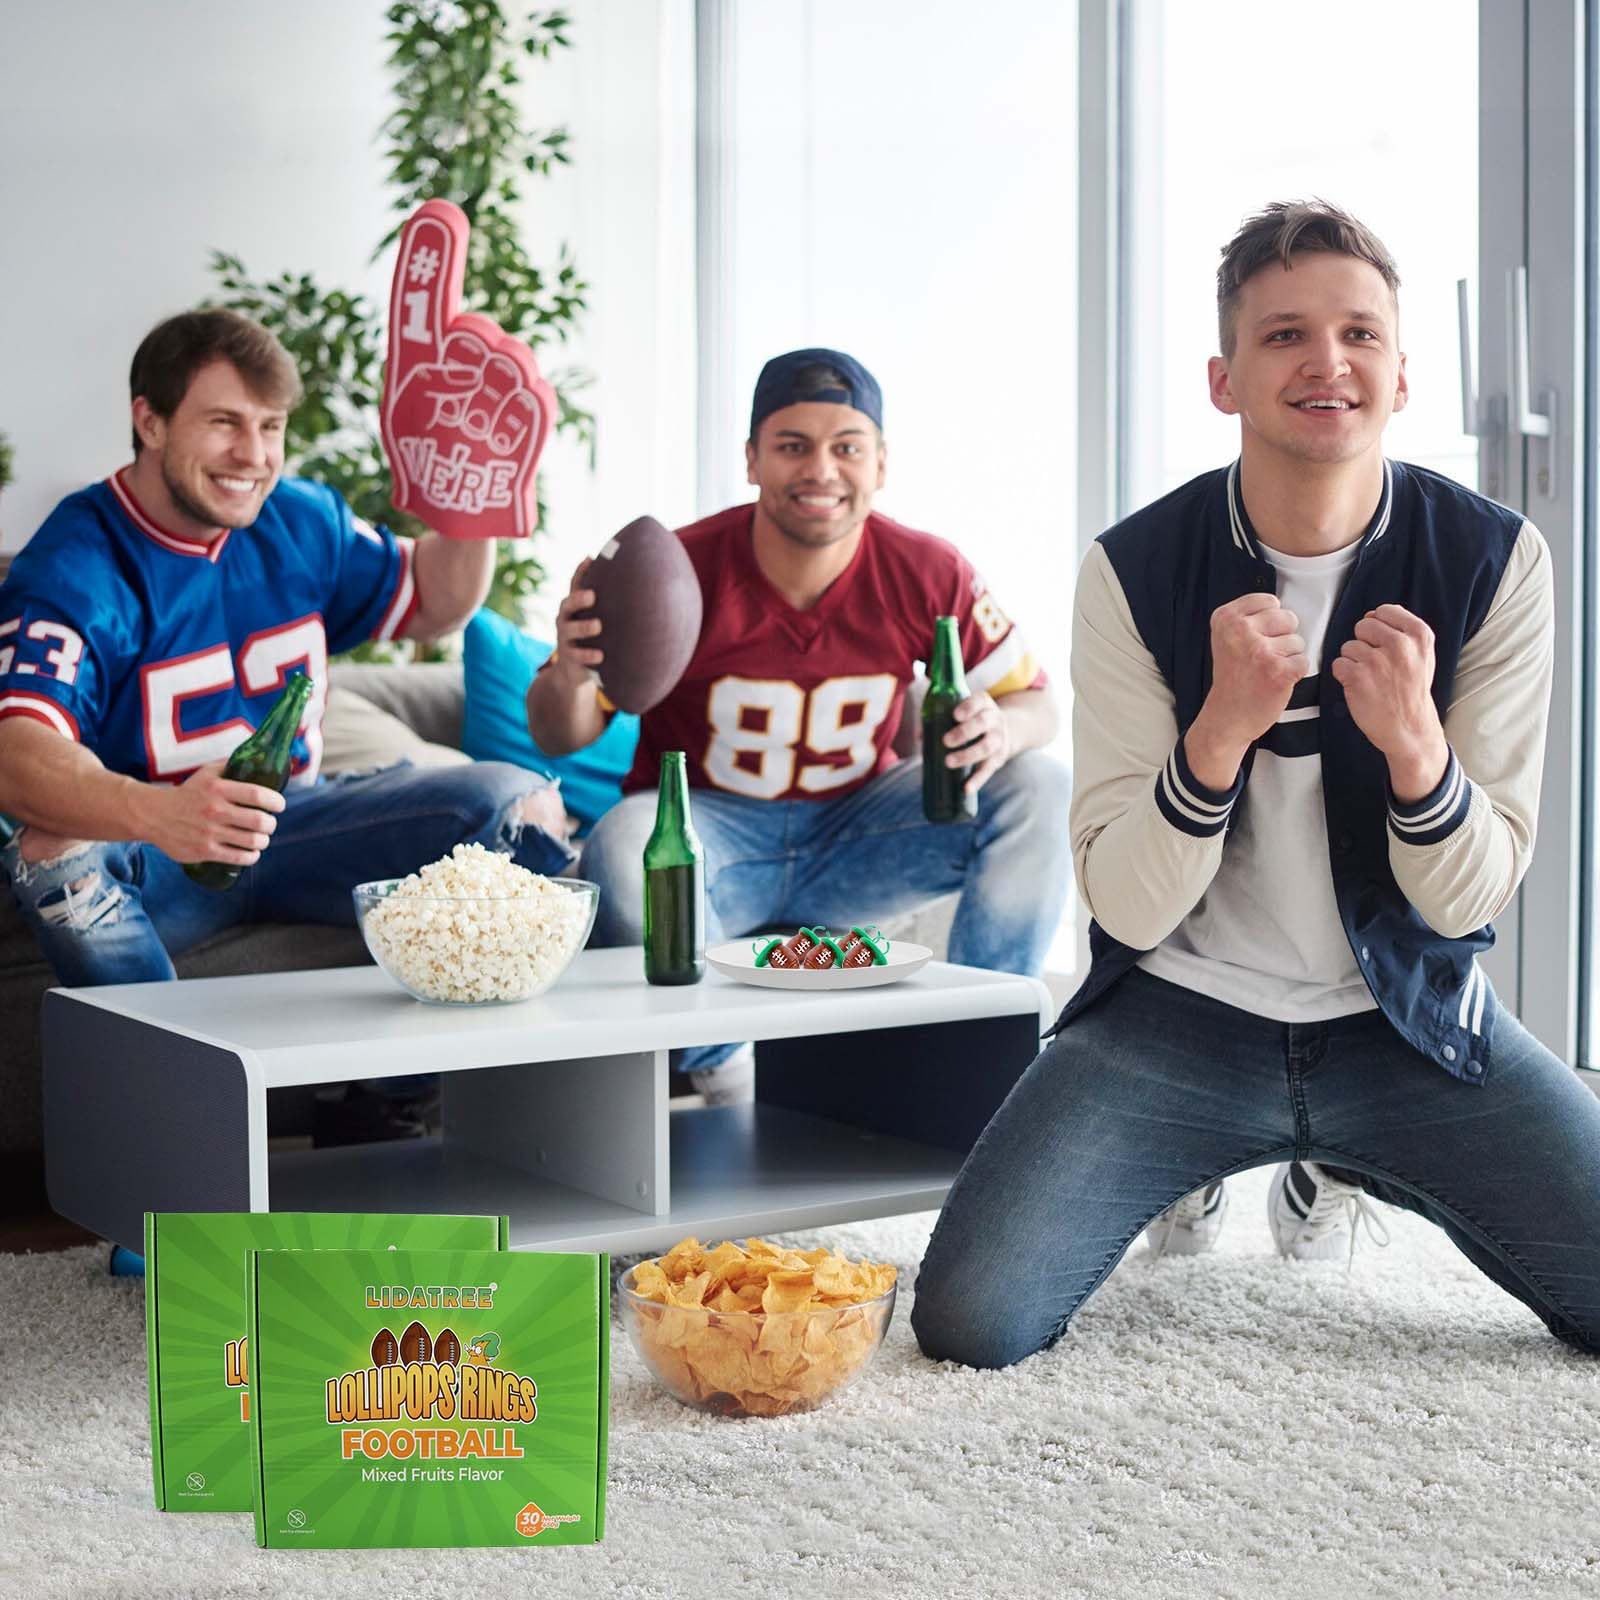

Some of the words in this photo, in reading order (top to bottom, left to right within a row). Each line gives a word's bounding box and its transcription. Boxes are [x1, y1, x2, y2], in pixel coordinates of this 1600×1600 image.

[402, 289, 432, 344] 1
[139, 611, 328, 785] 53
[703, 673, 897, 800] 89
[365, 1286, 494, 1309] LIDATREE
[325, 1361, 457, 1424] LOLLIPOPS
[459, 1363, 538, 1424] RINGS
[341, 1428, 525, 1459] FOOTBALL
[361, 1468, 407, 1482] Mixed
[411, 1467, 455, 1482] Fruits
[459, 1467, 504, 1482] Flavor
[520, 1512, 541, 1525] 30
